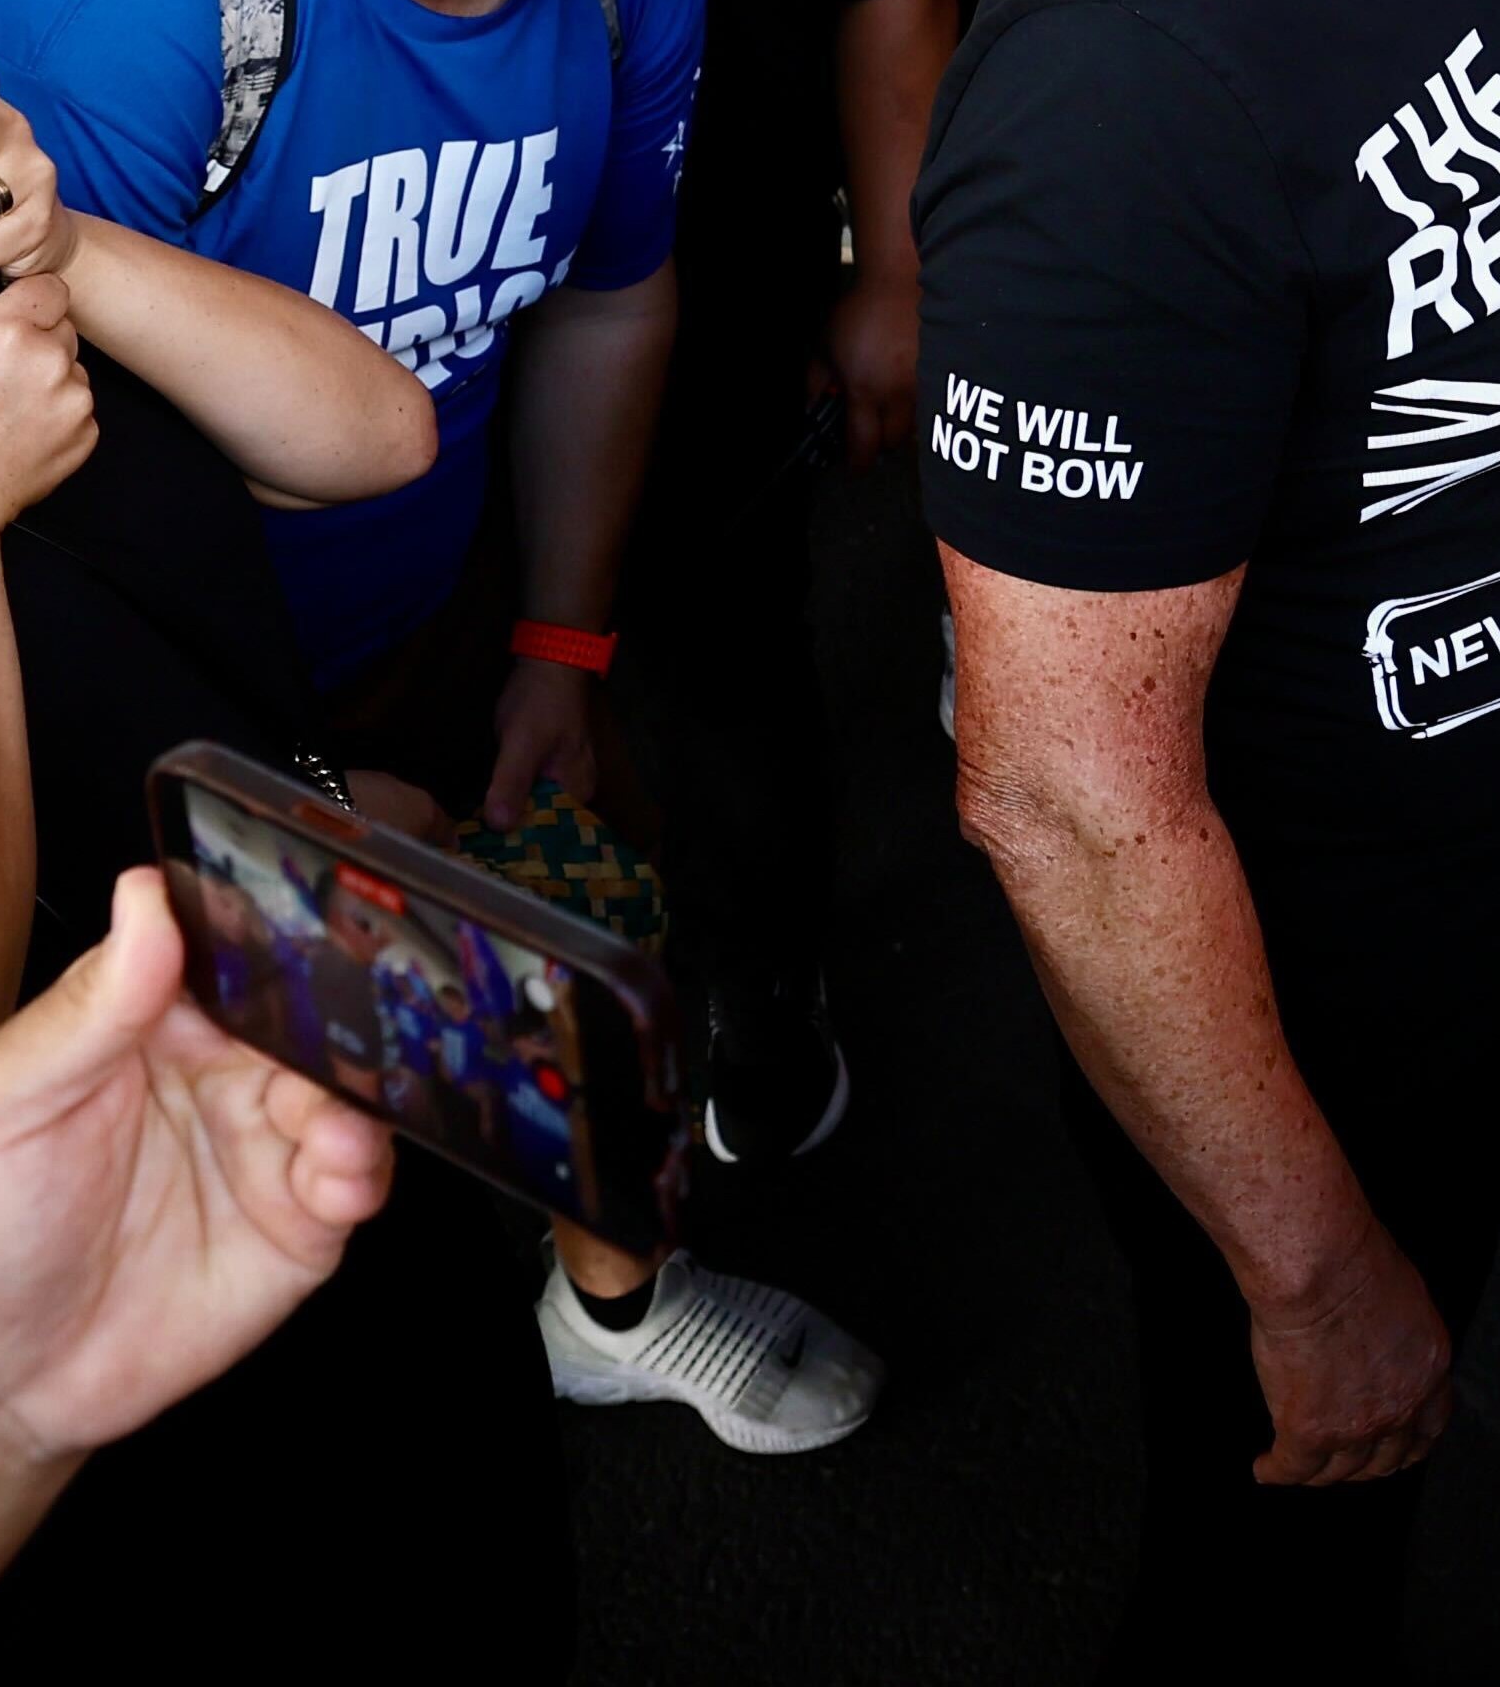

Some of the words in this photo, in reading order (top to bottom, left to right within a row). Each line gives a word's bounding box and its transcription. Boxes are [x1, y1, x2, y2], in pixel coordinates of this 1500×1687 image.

[309, 126, 559, 314] TRUE
[931, 413, 1010, 481] NOT
[1020, 450, 1145, 500] BOW
[946, 372, 1005, 434] WE
[1016, 400, 1133, 454] WILL
